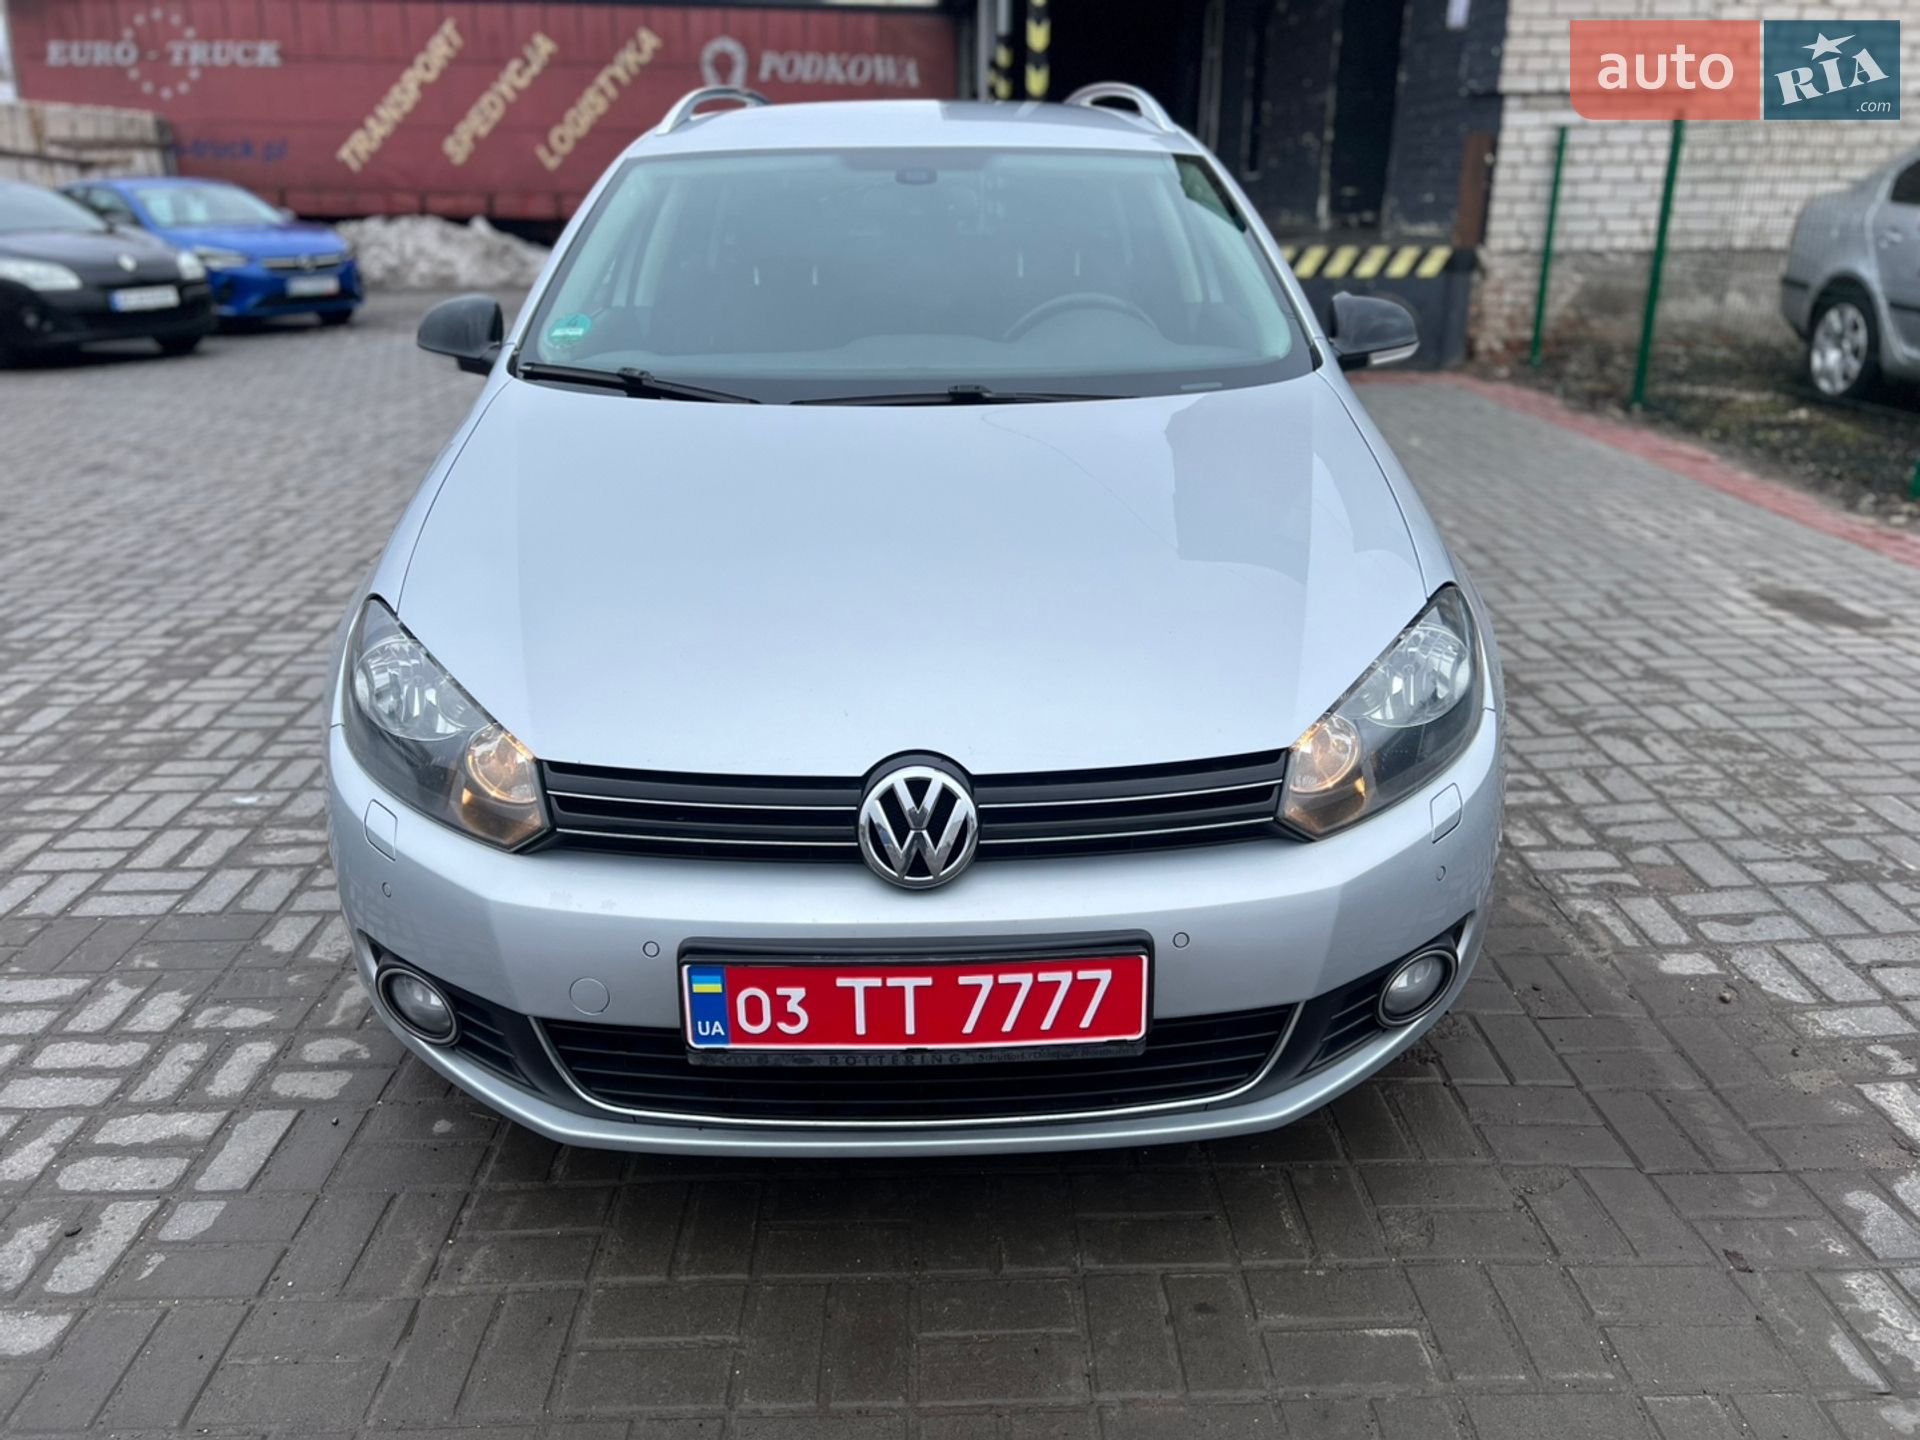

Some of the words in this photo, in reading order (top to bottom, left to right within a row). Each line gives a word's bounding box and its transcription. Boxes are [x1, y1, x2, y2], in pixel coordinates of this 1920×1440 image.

[46, 39, 140, 67] EURO
[166, 40, 282, 67] TRUCK
[758, 49, 920, 88] PODKOWA
[336, 17, 463, 172] TRANSPORT
[443, 32, 557, 165] SPEDYCJA
[535, 27, 662, 171] LOGISTYKA
[697, 1021, 726, 1036] UA
[736, 987, 810, 1035] 03
[836, 976, 934, 1036] TT
[958, 969, 1113, 1034] 7777
[829, 1054, 961, 1067] ROTTERING
